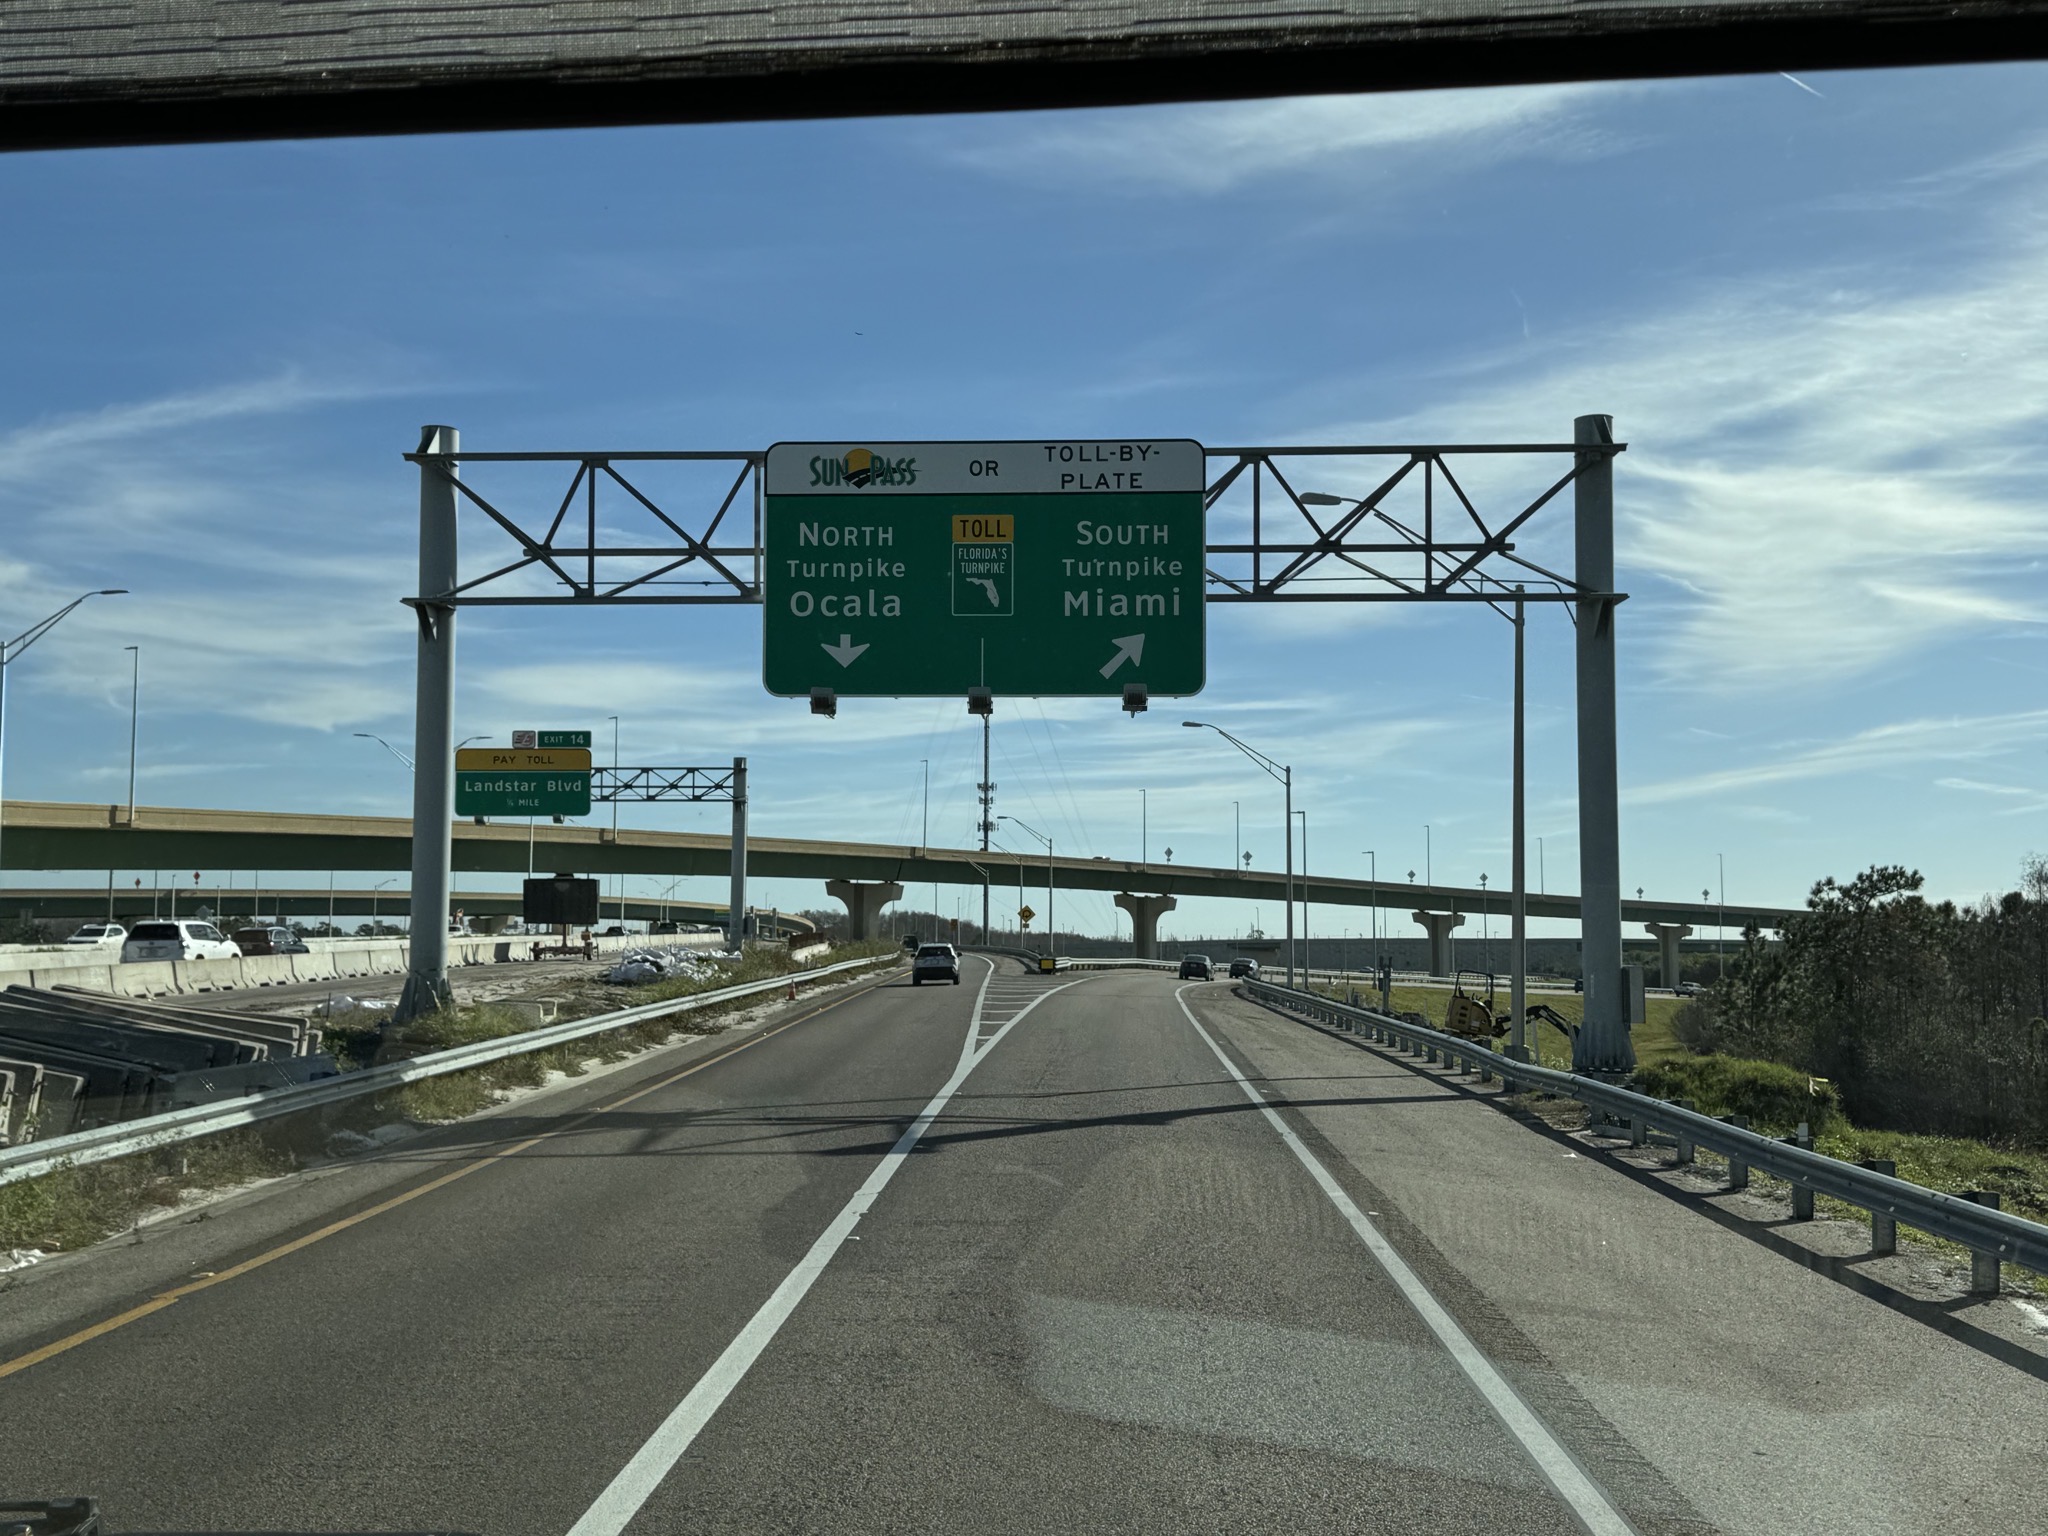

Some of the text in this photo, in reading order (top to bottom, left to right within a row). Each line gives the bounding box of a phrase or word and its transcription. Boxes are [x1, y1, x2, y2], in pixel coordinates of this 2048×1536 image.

[1044, 445, 1160, 463] TOLL-BY-
[969, 460, 999, 477] OR
[1060, 472, 1143, 490] PLATE
[799, 522, 894, 546] NORTH
[959, 519, 1007, 538] TOLL
[1076, 520, 1169, 545] SOUTH
[958, 547, 1008, 560] FLORIDA'S
[787, 558, 906, 582] Turnpike
[960, 562, 1005, 574] TURNPIKE
[1062, 557, 1183, 581] Turnpike
[790, 589, 902, 618] Ocala
[1064, 588, 1181, 617] Miami
[570, 735, 584, 744] 14
[493, 756, 554, 764] PAY TOLL
[465, 780, 582, 792] Landstar Blvd
